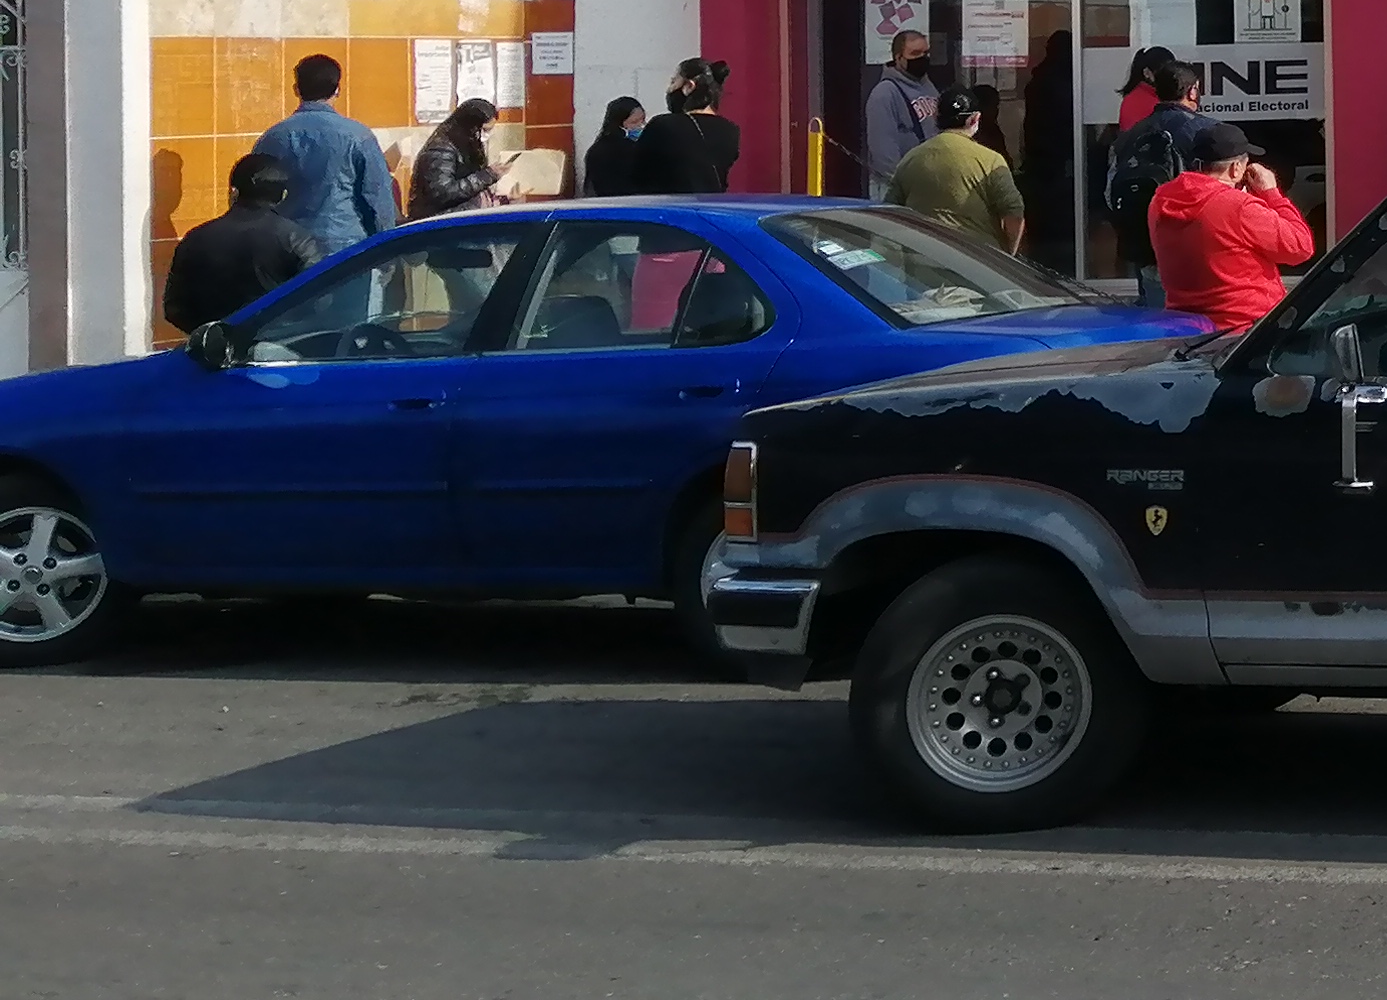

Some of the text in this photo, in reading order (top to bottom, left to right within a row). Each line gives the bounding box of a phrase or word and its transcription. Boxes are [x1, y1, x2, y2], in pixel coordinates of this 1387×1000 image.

[1193, 59, 1308, 96] INE
[1197, 99, 1309, 113] acional Electoral
